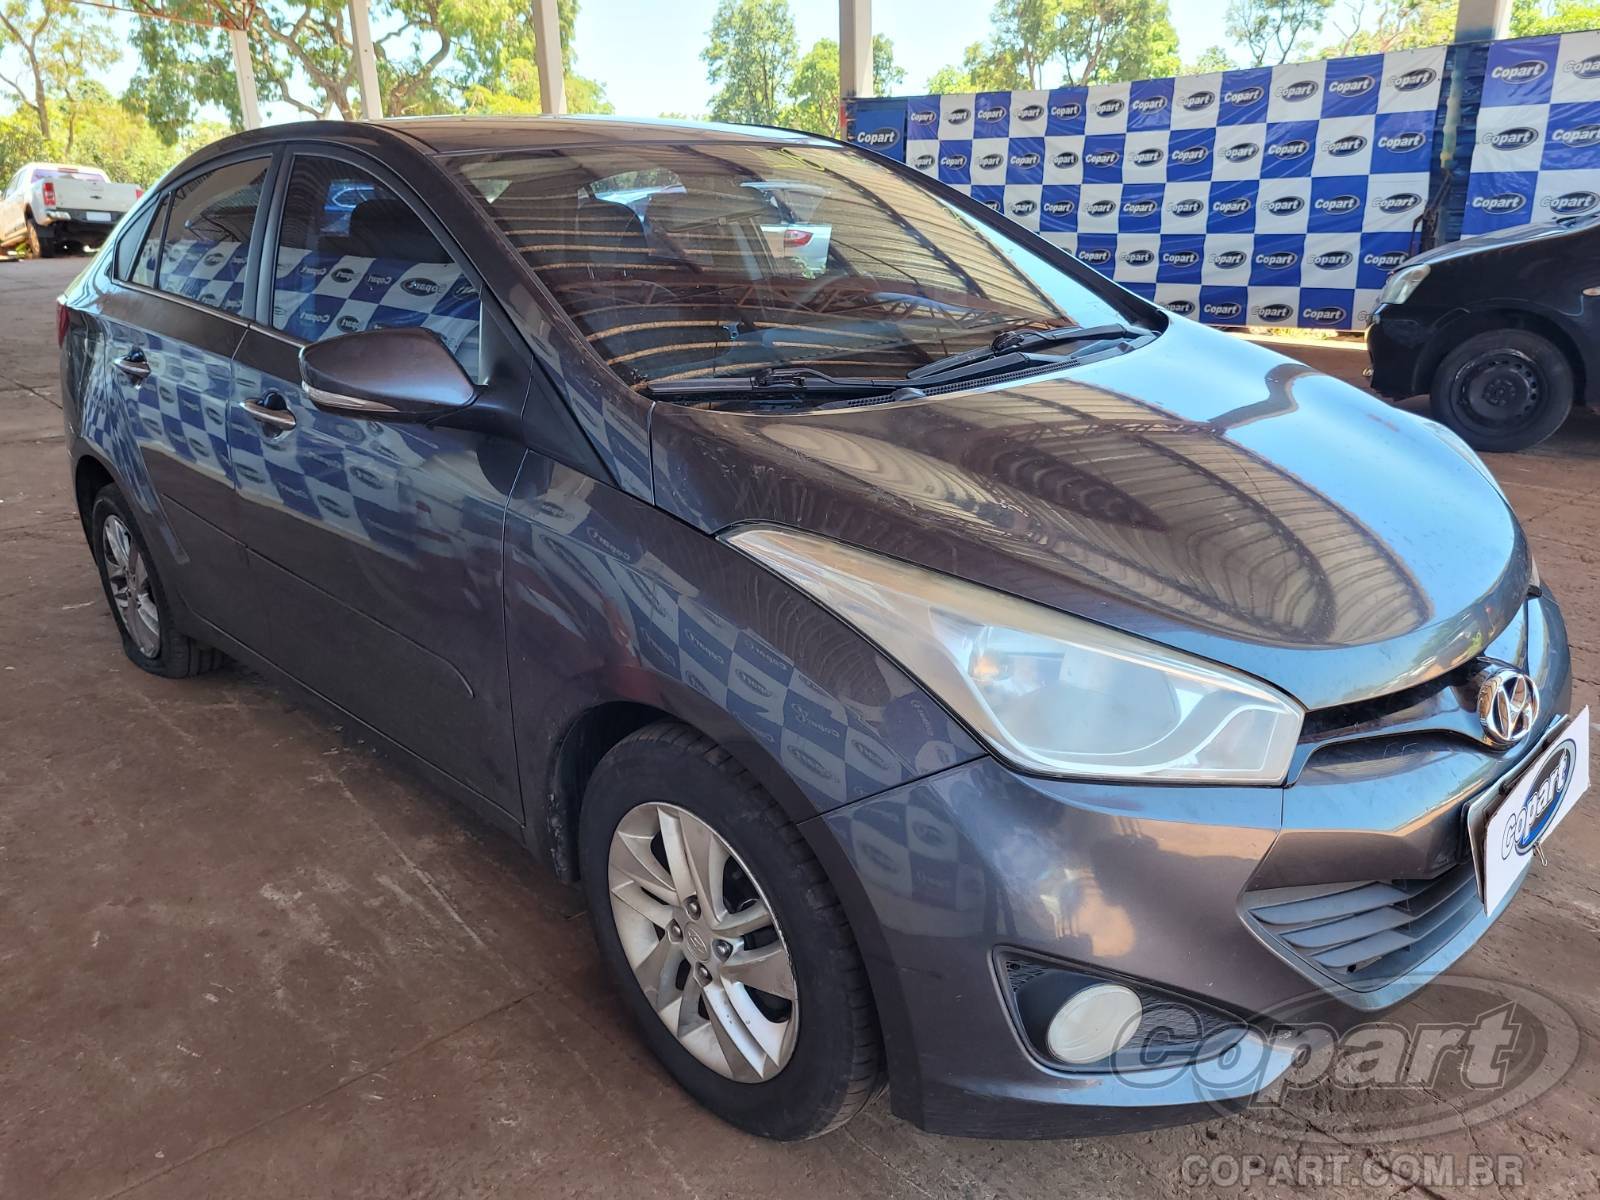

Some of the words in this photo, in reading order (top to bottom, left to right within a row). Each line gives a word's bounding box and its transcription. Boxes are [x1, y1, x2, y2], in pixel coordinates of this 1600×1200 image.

[1491, 62, 1542, 78] Copart
[1563, 60, 1600, 74] Copa
[1329, 78, 1370, 93] Copart
[1224, 90, 1260, 104] Copart
[1133, 98, 1165, 110] Copart
[910, 111, 934, 122] Copart
[978, 107, 1004, 120] Copart
[1051, 104, 1078, 118] Copart
[857, 131, 895, 145] Copart
[1378, 135, 1421, 149] Copart
[1482, 131, 1531, 145] Copart
[1172, 148, 1205, 162] Copart
[1268, 141, 1306, 157] Copart
[941, 156, 964, 167] Copart
[1010, 155, 1038, 166] Copart
[1086, 152, 1117, 165] Copart
[1044, 201, 1073, 213] Copart
[1123, 201, 1155, 213] Copart
[1212, 201, 1247, 213] Copart
[1314, 199, 1355, 211] Copart
[1372, 197, 1414, 209] Copart
[1472, 196, 1519, 210] Copart
[1540, 195, 1591, 208] Copart
[1078, 250, 1107, 262] Copart
[1163, 252, 1195, 263] Copart
[1255, 254, 1293, 265] Copart
[1363, 254, 1404, 265] Copart
[1163, 303, 1190, 314] opart
[1204, 304, 1237, 315] Copart
[1303, 308, 1341, 320] Copart
[1501, 748, 1568, 860] Copart
